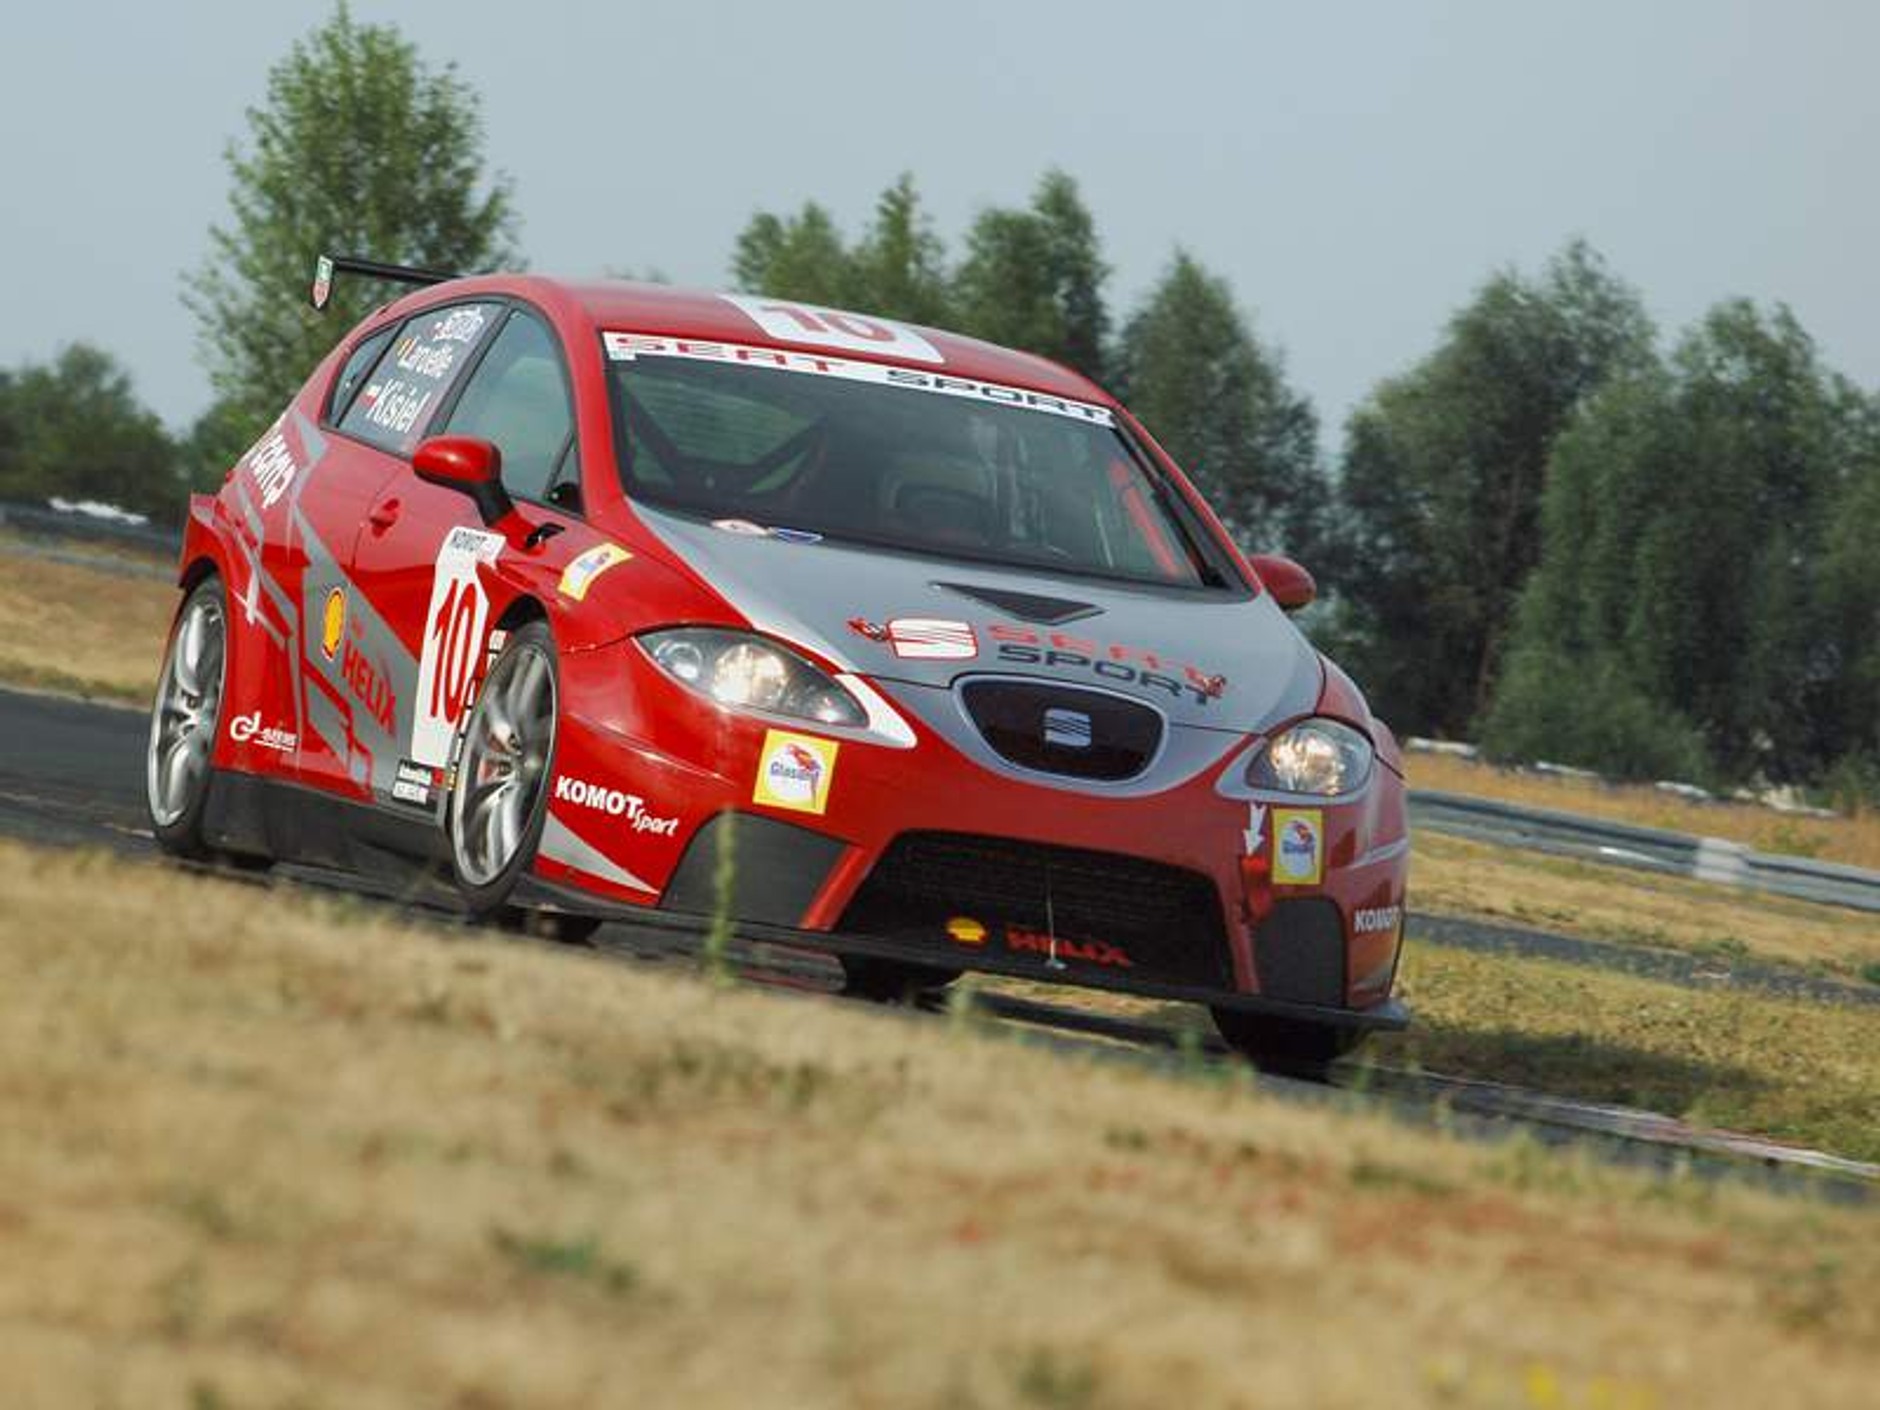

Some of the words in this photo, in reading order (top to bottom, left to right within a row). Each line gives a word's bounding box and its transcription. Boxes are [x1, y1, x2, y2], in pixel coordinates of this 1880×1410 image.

[760, 304, 897, 342] 10
[615, 337, 845, 373] SEAT
[887, 369, 1110, 418] SPORT
[429, 577, 477, 724] 10
[997, 643, 1208, 705] SPORT
[341, 639, 398, 736] HELIX
[555, 774, 644, 819] KOMOT
